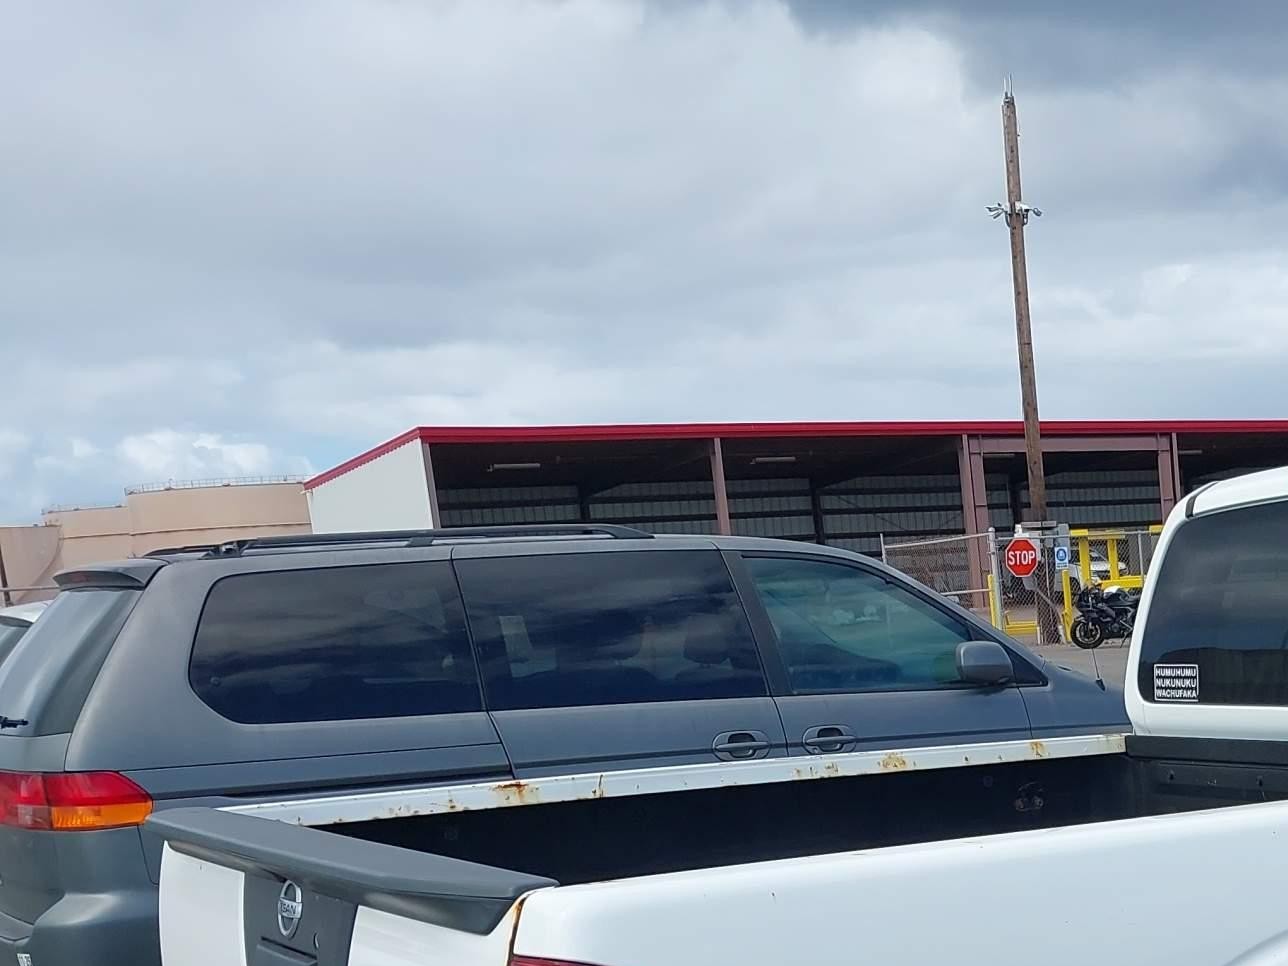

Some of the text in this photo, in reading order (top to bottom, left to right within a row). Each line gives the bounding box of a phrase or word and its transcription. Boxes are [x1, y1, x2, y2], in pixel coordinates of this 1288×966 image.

[1008, 550, 1036, 566] STOP
[1155, 667, 1197, 677] HUMUHUMU
[1155, 678, 1197, 688] NUKUNUKU
